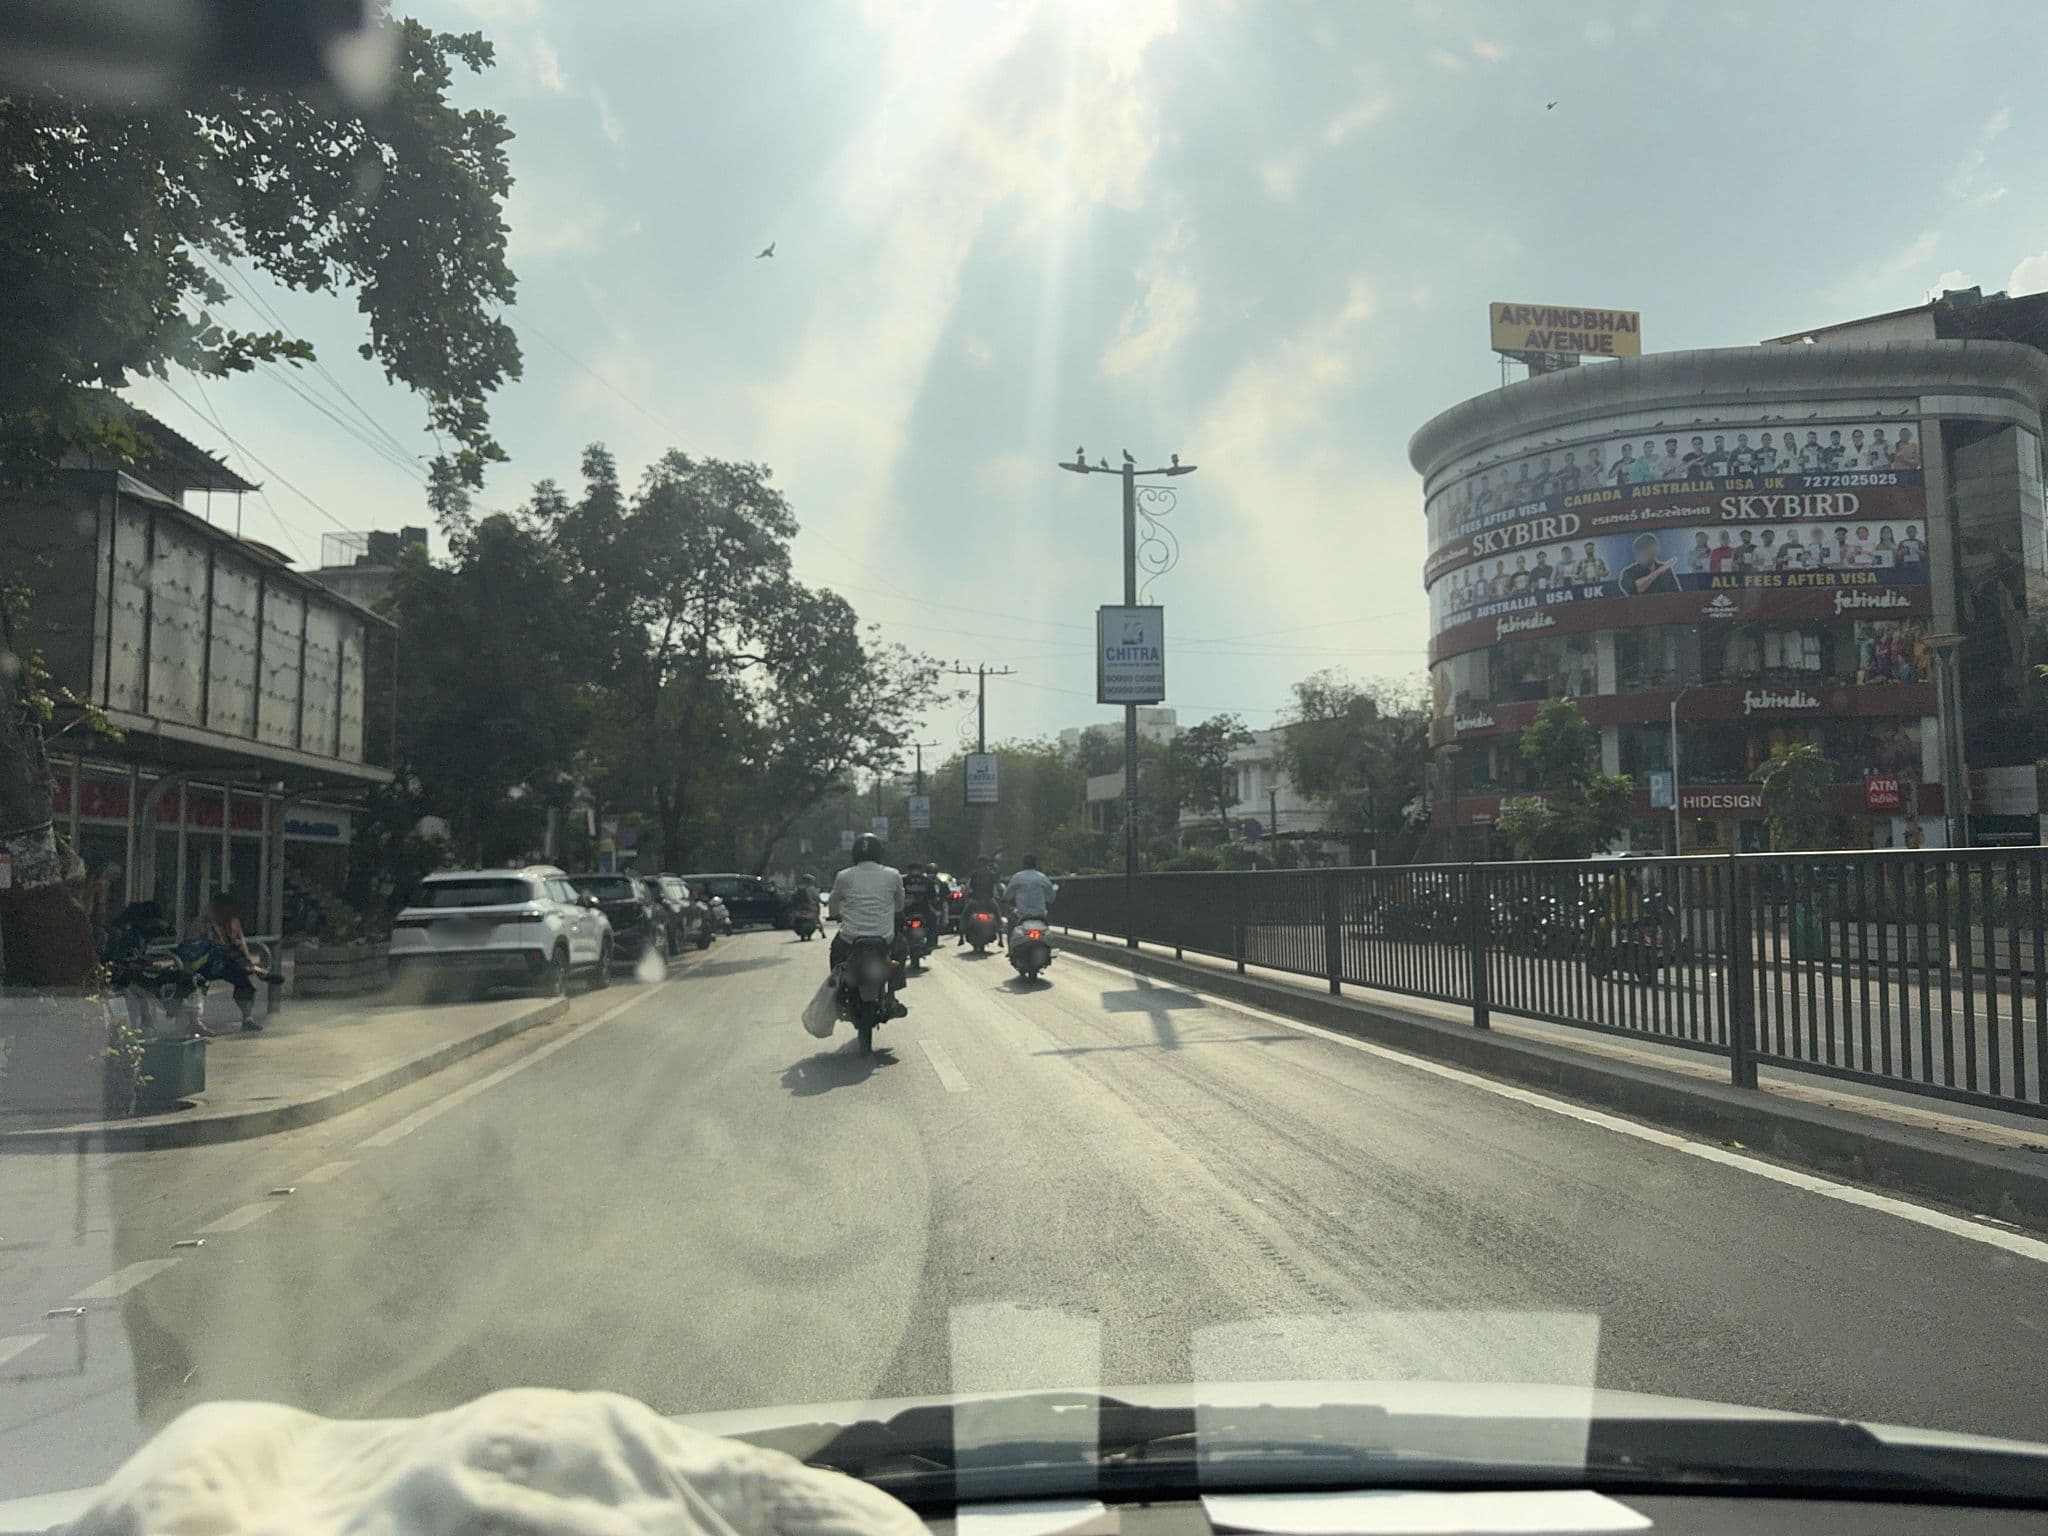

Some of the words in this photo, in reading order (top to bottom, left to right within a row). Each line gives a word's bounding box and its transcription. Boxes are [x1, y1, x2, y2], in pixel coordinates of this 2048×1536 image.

[1499, 305, 1637, 333] ARVINDBHAI
[1525, 329, 1614, 353] AVENUE
[1564, 490, 1622, 507] CANADA
[1632, 480, 1715, 498] AUSTRALIA
[1725, 479, 1754, 490] USA
[1765, 477, 1785, 489] UK
[1802, 473, 1898, 488] 7272025025
[1461, 519, 1482, 536] FEES
[1483, 508, 1516, 527] AFTER
[1519, 501, 1548, 517] VISA
[1721, 492, 1860, 520] SKYBIRD
[1472, 513, 1581, 557] SKYBIRD
[1711, 575, 1738, 589] ALL
[1744, 575, 1782, 588] FEES
[1787, 573, 1836, 587] AFTER
[1841, 572, 1878, 585] VISA
[1477, 596, 1538, 618] AUSTRALIA
[1546, 589, 1574, 604] USA
[1584, 586, 1604, 599] UK
[1834, 589, 1911, 615] fabindia
[1496, 612, 1557, 641] fabindia
[1105, 646, 1159, 661] CHITRA
[1743, 690, 1820, 714] fabindia
[1870, 780, 1898, 792] ATM
[1683, 795, 1762, 809] HIDESIGN
